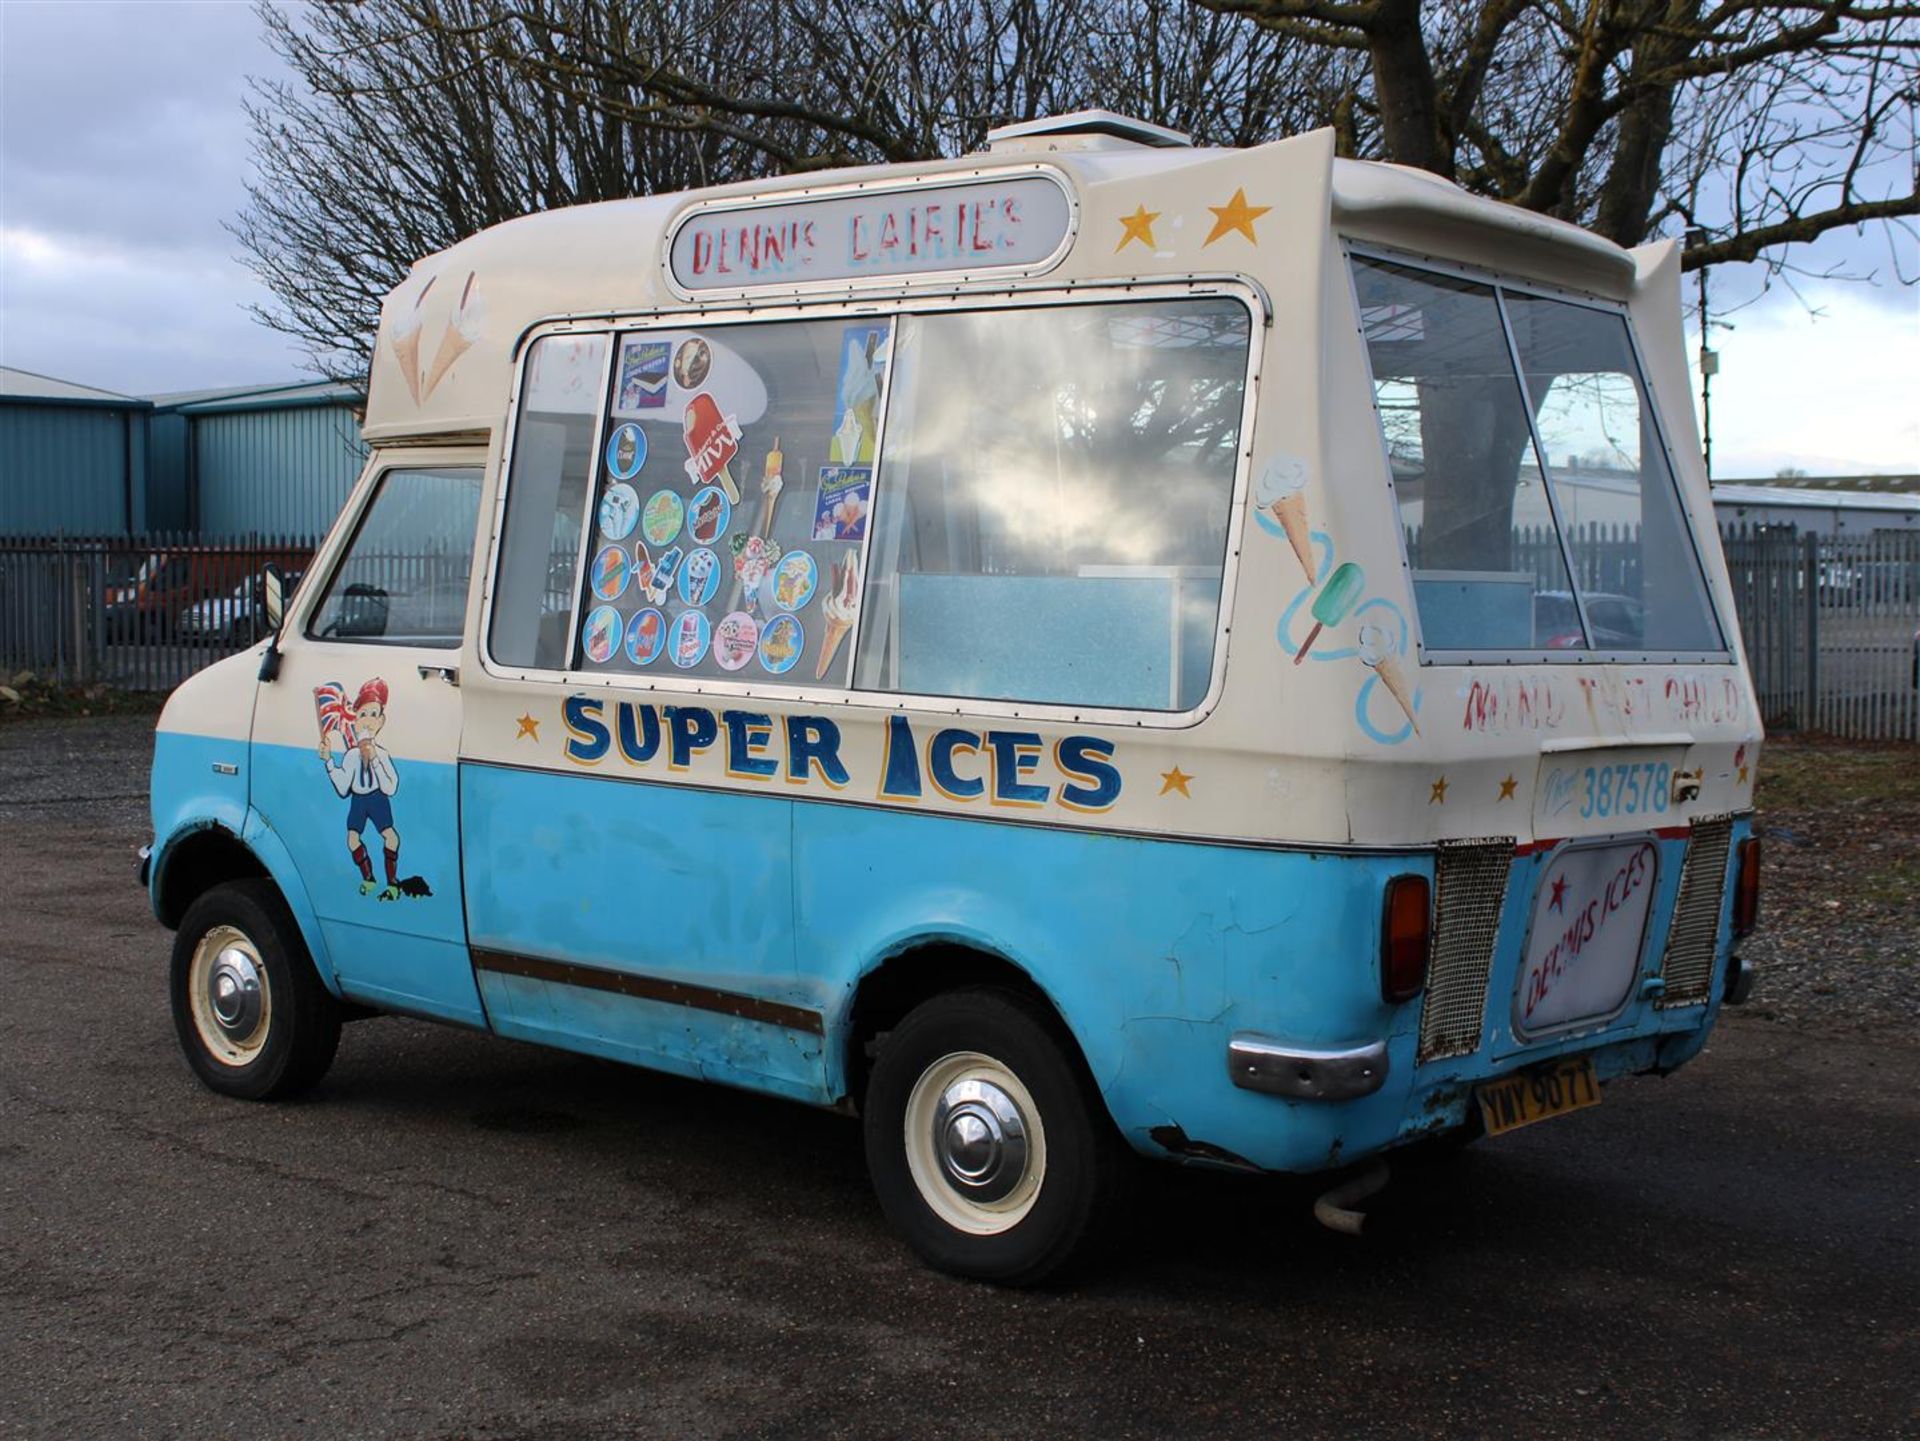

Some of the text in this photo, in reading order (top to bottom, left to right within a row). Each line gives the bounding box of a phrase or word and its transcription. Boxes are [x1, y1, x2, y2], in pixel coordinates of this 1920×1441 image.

[562, 692, 1123, 813] SUPER ICES
[1580, 762, 1670, 819] 387578
